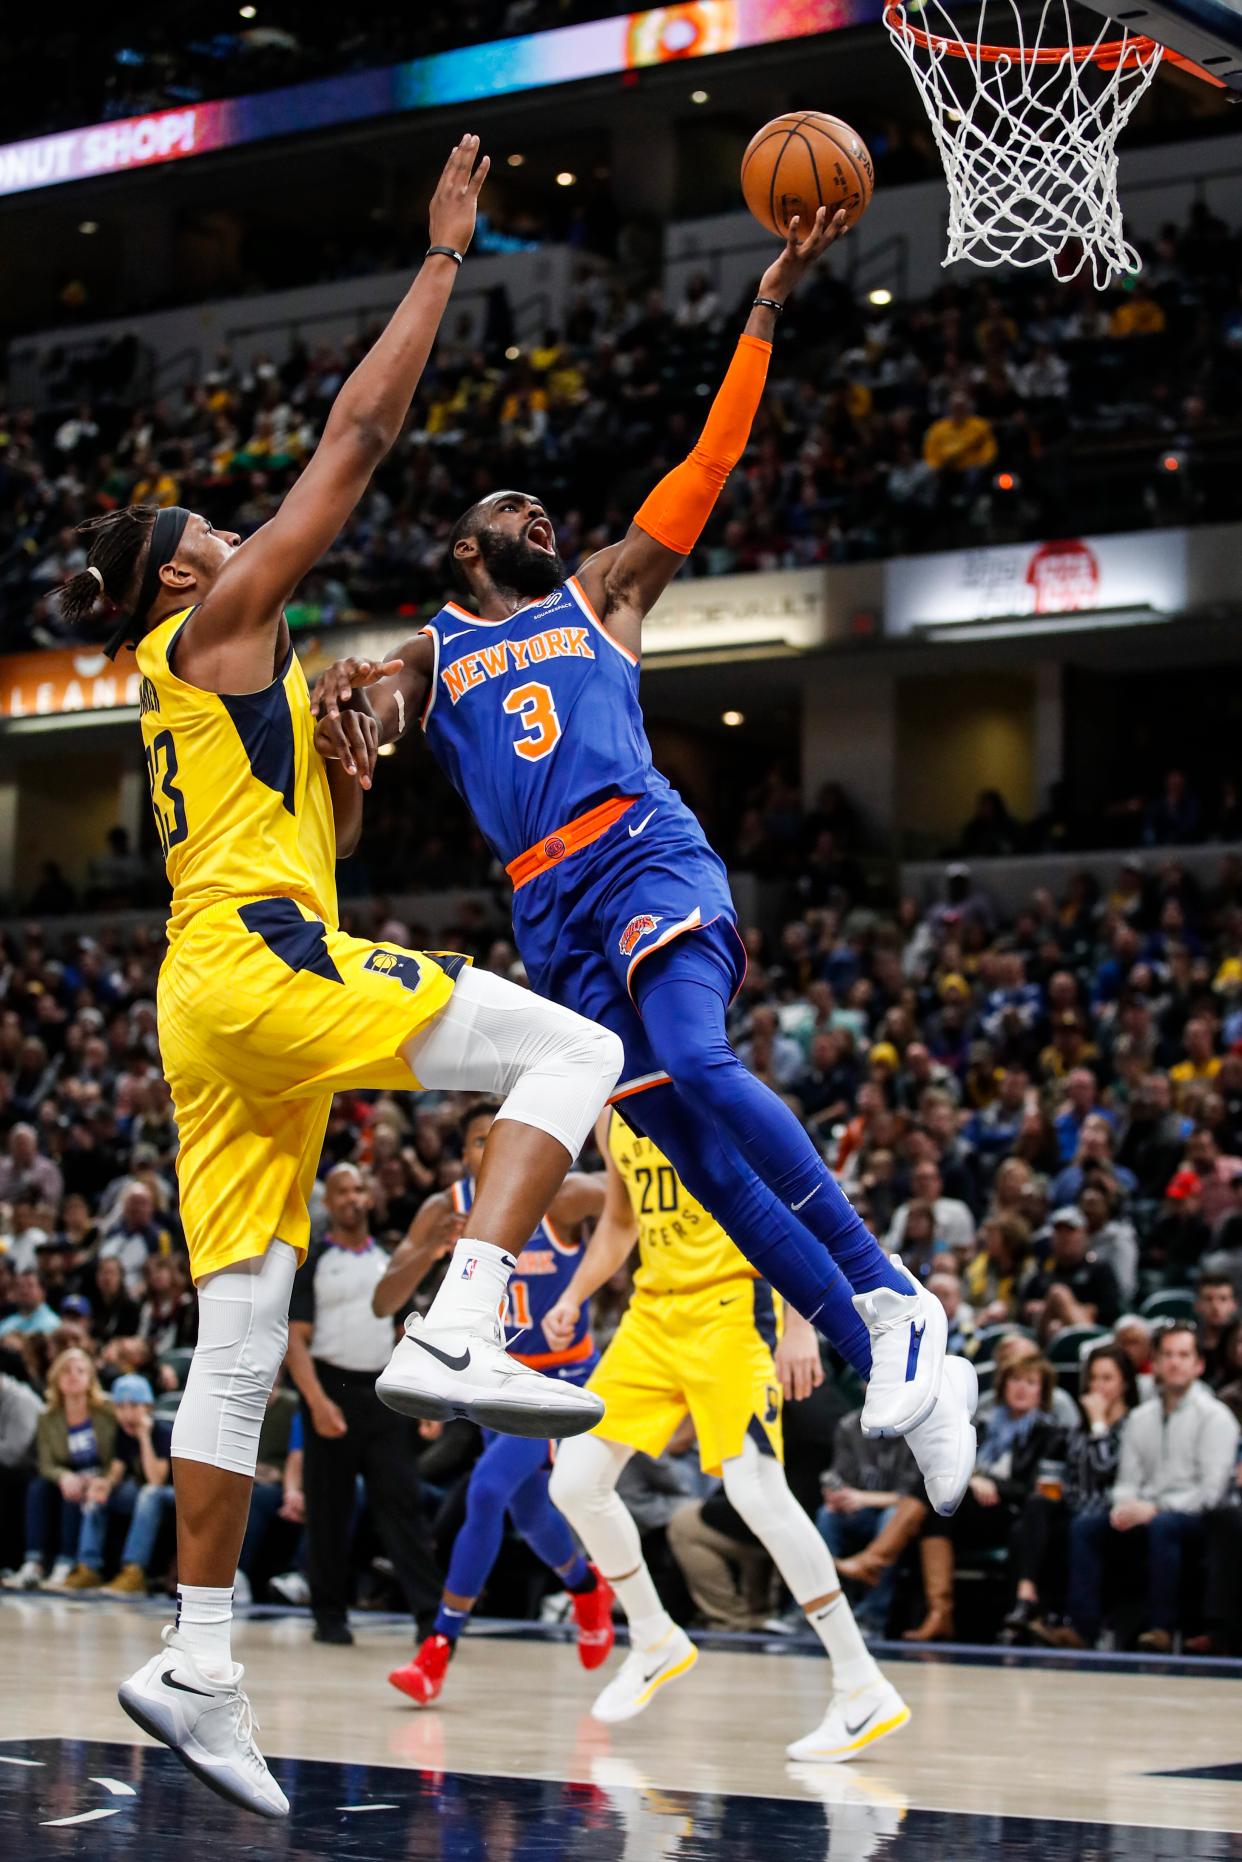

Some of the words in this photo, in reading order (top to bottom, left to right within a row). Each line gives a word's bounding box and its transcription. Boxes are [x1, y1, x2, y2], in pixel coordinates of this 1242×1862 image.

[0, 136, 79, 190] NUT
[82, 110, 197, 169] SHOP!
[533, 602, 573, 620] SQUARESPACE
[502, 681, 563, 762] 3
[634, 1165, 678, 1214] 20
[641, 1208, 700, 1248] CERS
